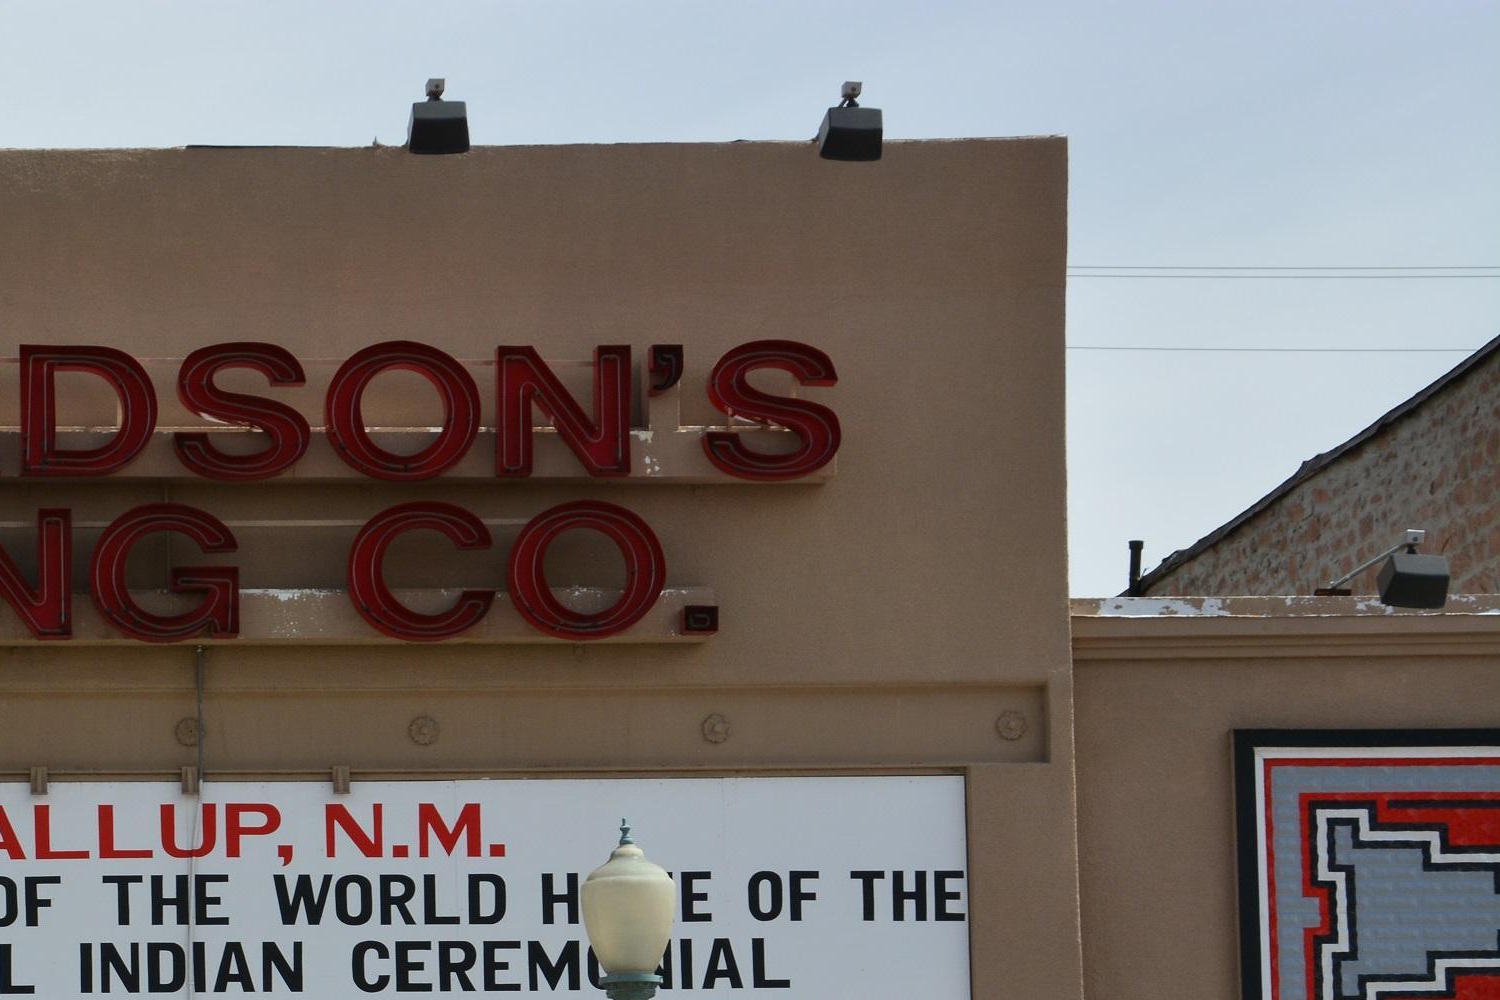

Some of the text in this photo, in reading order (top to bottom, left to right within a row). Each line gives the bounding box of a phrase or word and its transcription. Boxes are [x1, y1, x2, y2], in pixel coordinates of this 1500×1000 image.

[347, 500, 719, 641] CO.
[326, 804, 505, 857] N.M.
[103, 875, 229, 925] THE
[273, 874, 506, 925] WORLD
[542, 872, 711, 924] HE
[748, 871, 819, 921] OF
[851, 871, 965, 921] THE
[80, 942, 302, 993] INDIAN
